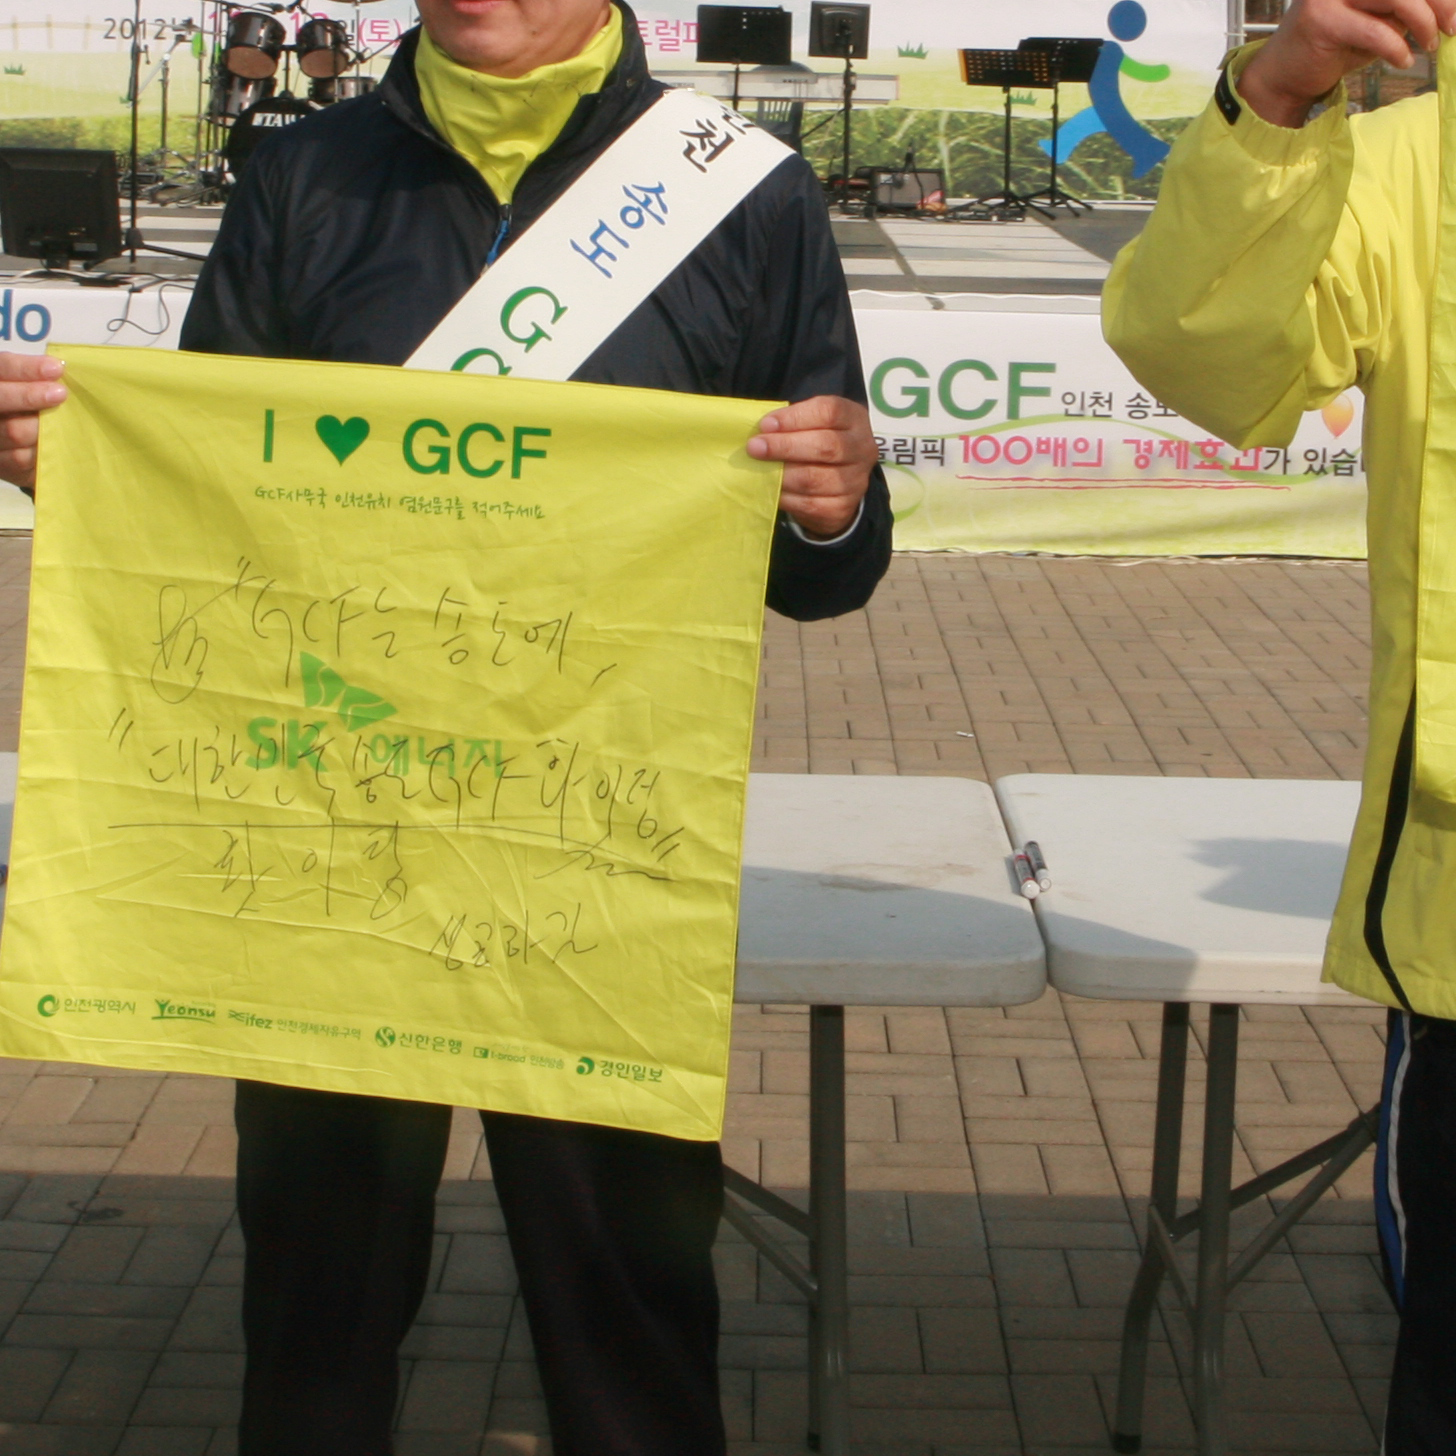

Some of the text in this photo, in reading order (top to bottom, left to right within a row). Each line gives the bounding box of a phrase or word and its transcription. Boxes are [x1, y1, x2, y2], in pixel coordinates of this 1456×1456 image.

[569, 180, 669, 279] 송도
[868, 357, 1057, 421] GCF
[1060, 390, 1114, 419] 인천
[263, 409, 552, 480] I GCF
[957, 434, 1103, 469] 100배의
[1303, 447, 1367, 476] 있습
[255, 485, 545, 520] GCF사무국 인천유치 염원문구를 적어주세요
[246, 716, 504, 779] SK 에너지
[64, 997, 136, 1015] 인천광역시
[155, 998, 216, 1019] Yeonsu
[245, 1014, 273, 1030] ifez
[277, 1018, 361, 1041] 인천경제자유구역
[399, 1031, 462, 1055] 신한은행
[599, 1060, 663, 1083] 경인일보
